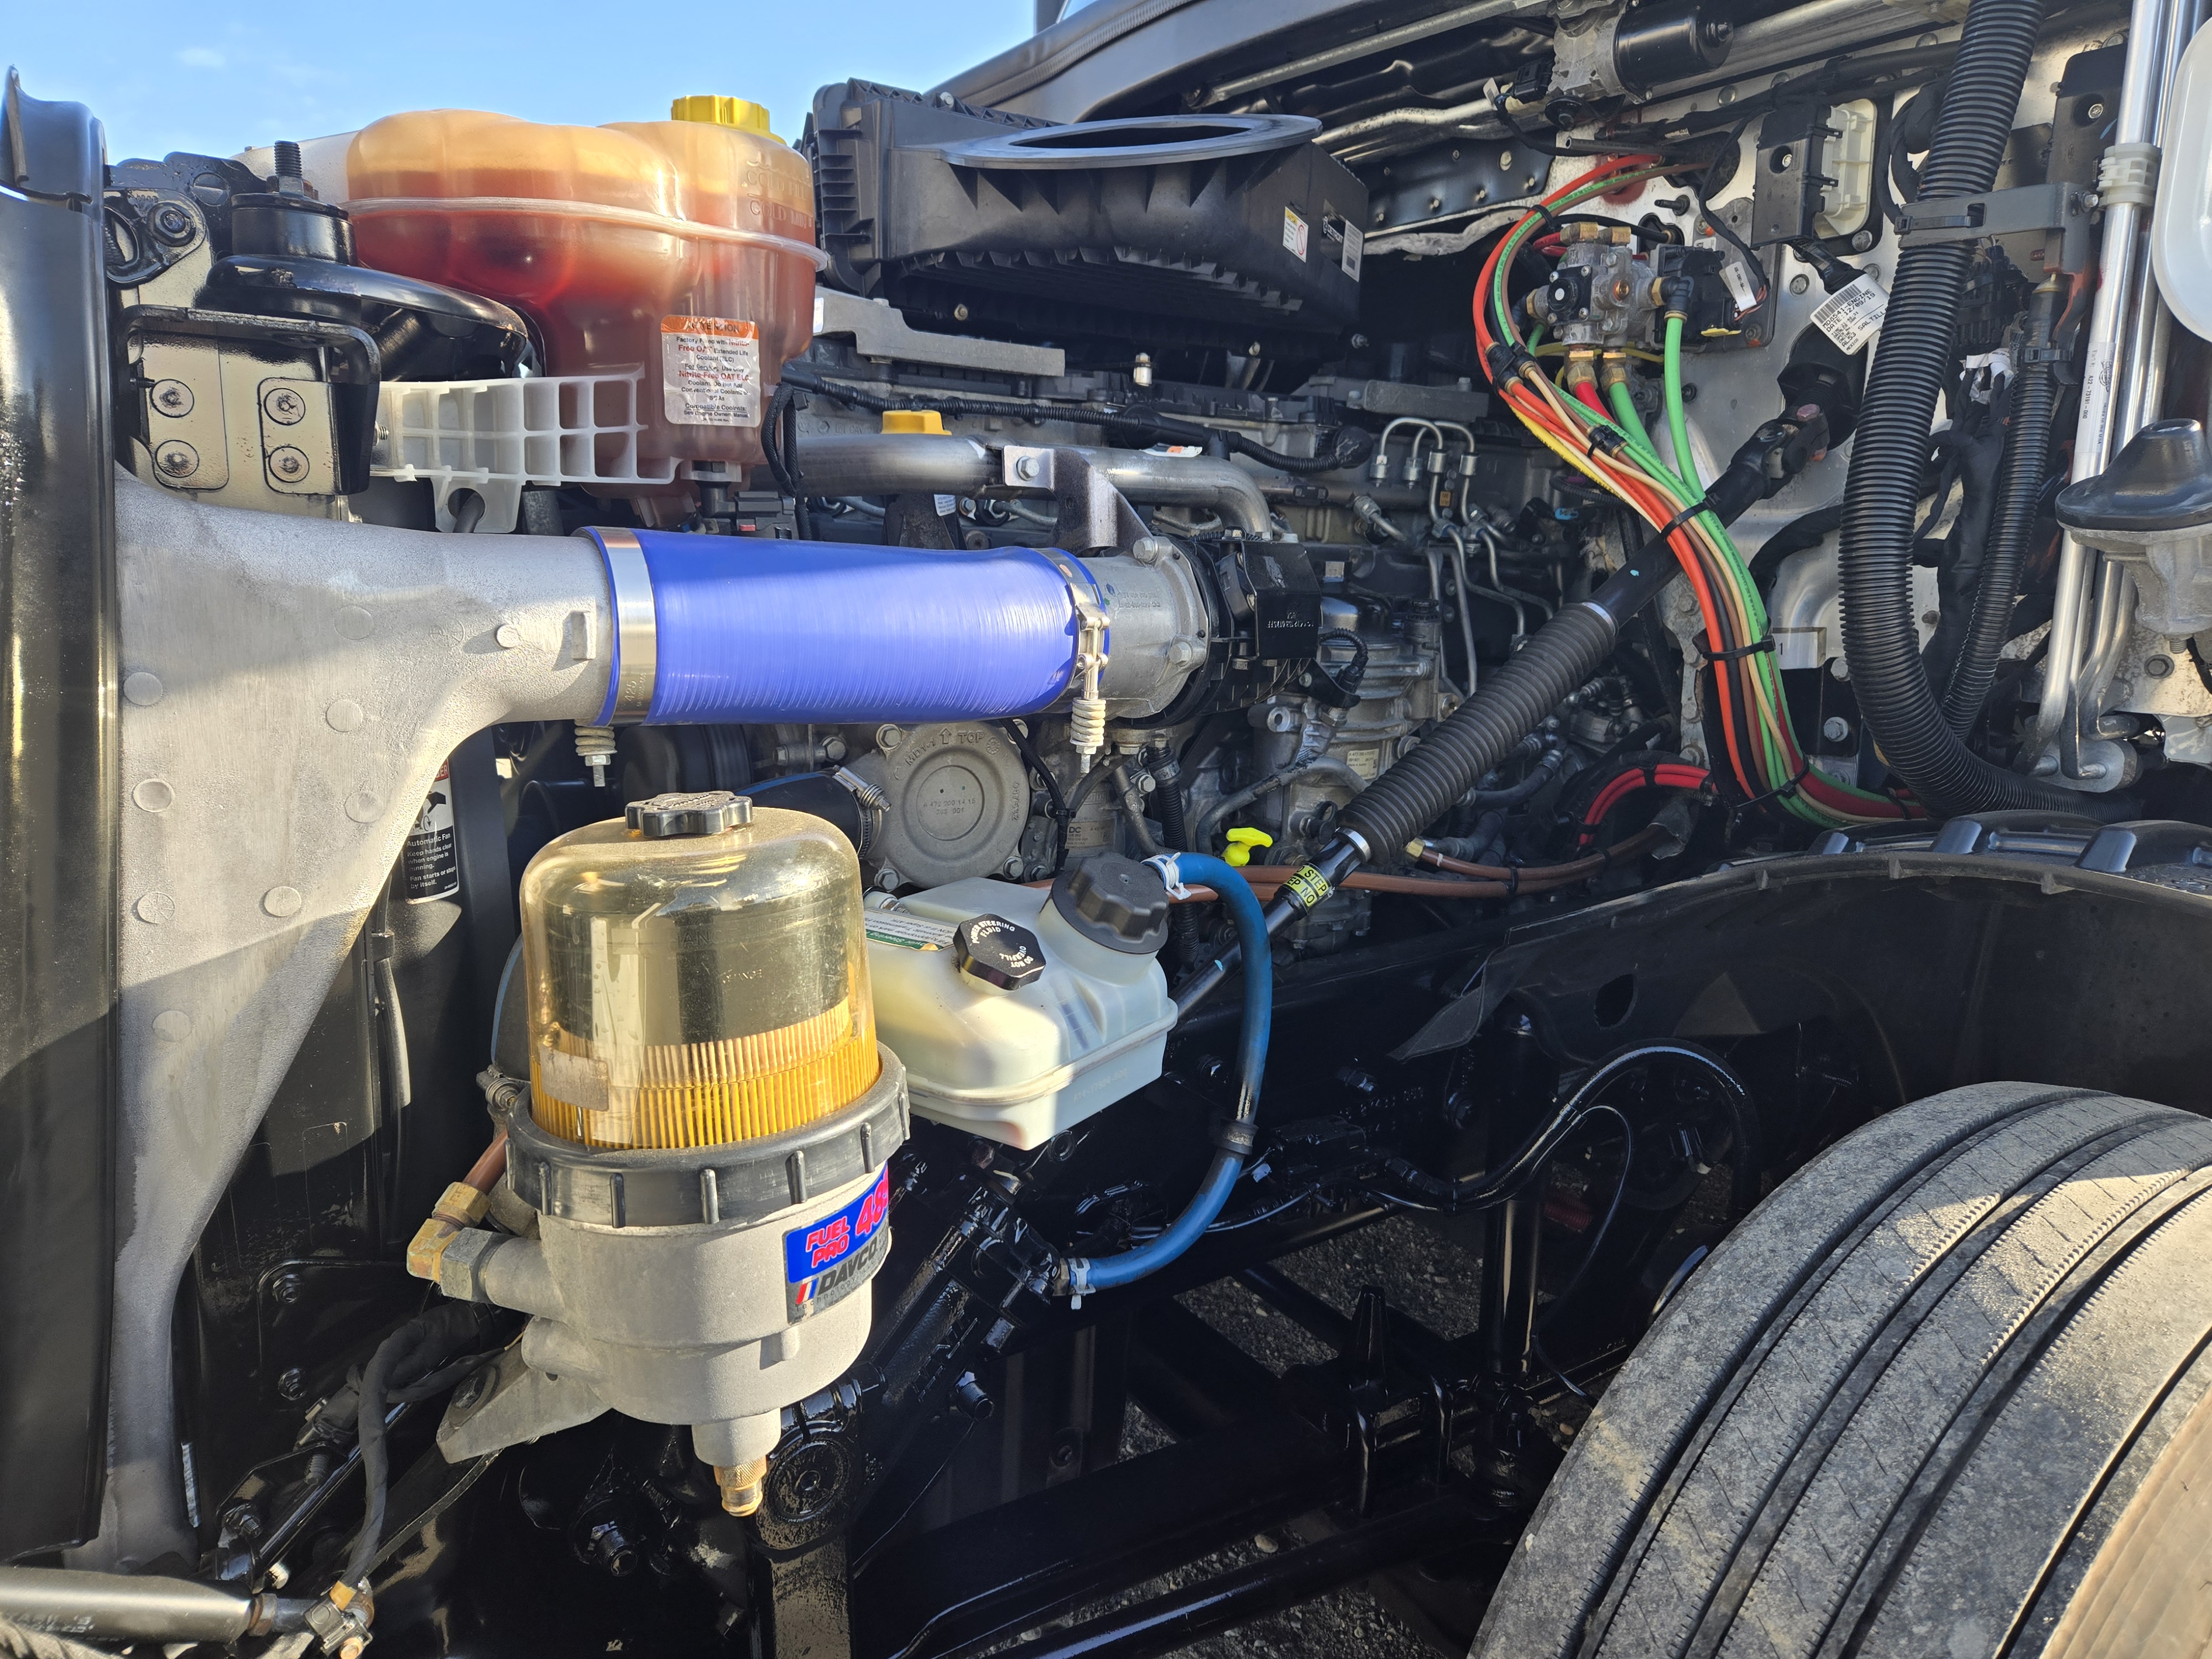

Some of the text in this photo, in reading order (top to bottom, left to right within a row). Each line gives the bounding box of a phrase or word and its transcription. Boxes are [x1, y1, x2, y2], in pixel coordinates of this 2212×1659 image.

[750, 200, 786, 221] COLD
[1822, 289, 1872, 328] MD8541-ENGINE
[688, 321, 740, 332] ATENION
[1841, 332, 1856, 347] AL53
[679, 371, 719, 379] Nitrite-Free
[957, 731, 985, 744] TOP
[436, 764, 448, 778] GER
[1011, 781, 1020, 821] 047532
[406, 832, 451, 847] Automatic Fan
[407, 842, 452, 858] Keep hands clear
[408, 857, 425, 865] when
[426, 853, 444, 863] engine
[409, 864, 435, 873] running.
[422, 871, 440, 880] starts
[446, 865, 456, 875] stops
[410, 881, 419, 890] by
[420, 878, 437, 888] itself.
[1304, 869, 1327, 892] STEP
[1286, 877, 1315, 904] EP NO
[871, 932, 905, 943] Steering
[971, 920, 1015, 943] POWER STEERING
[980, 926, 1001, 938] FLUID
[999, 946, 1027, 961] OVERFILL
[1024, 956, 1034, 964] DO
[805, 1215, 851, 1253] FUEL
[854, 1166, 889, 1238] 48
[811, 1233, 850, 1269] PRO
[817, 1235, 878, 1296] DAVCO
